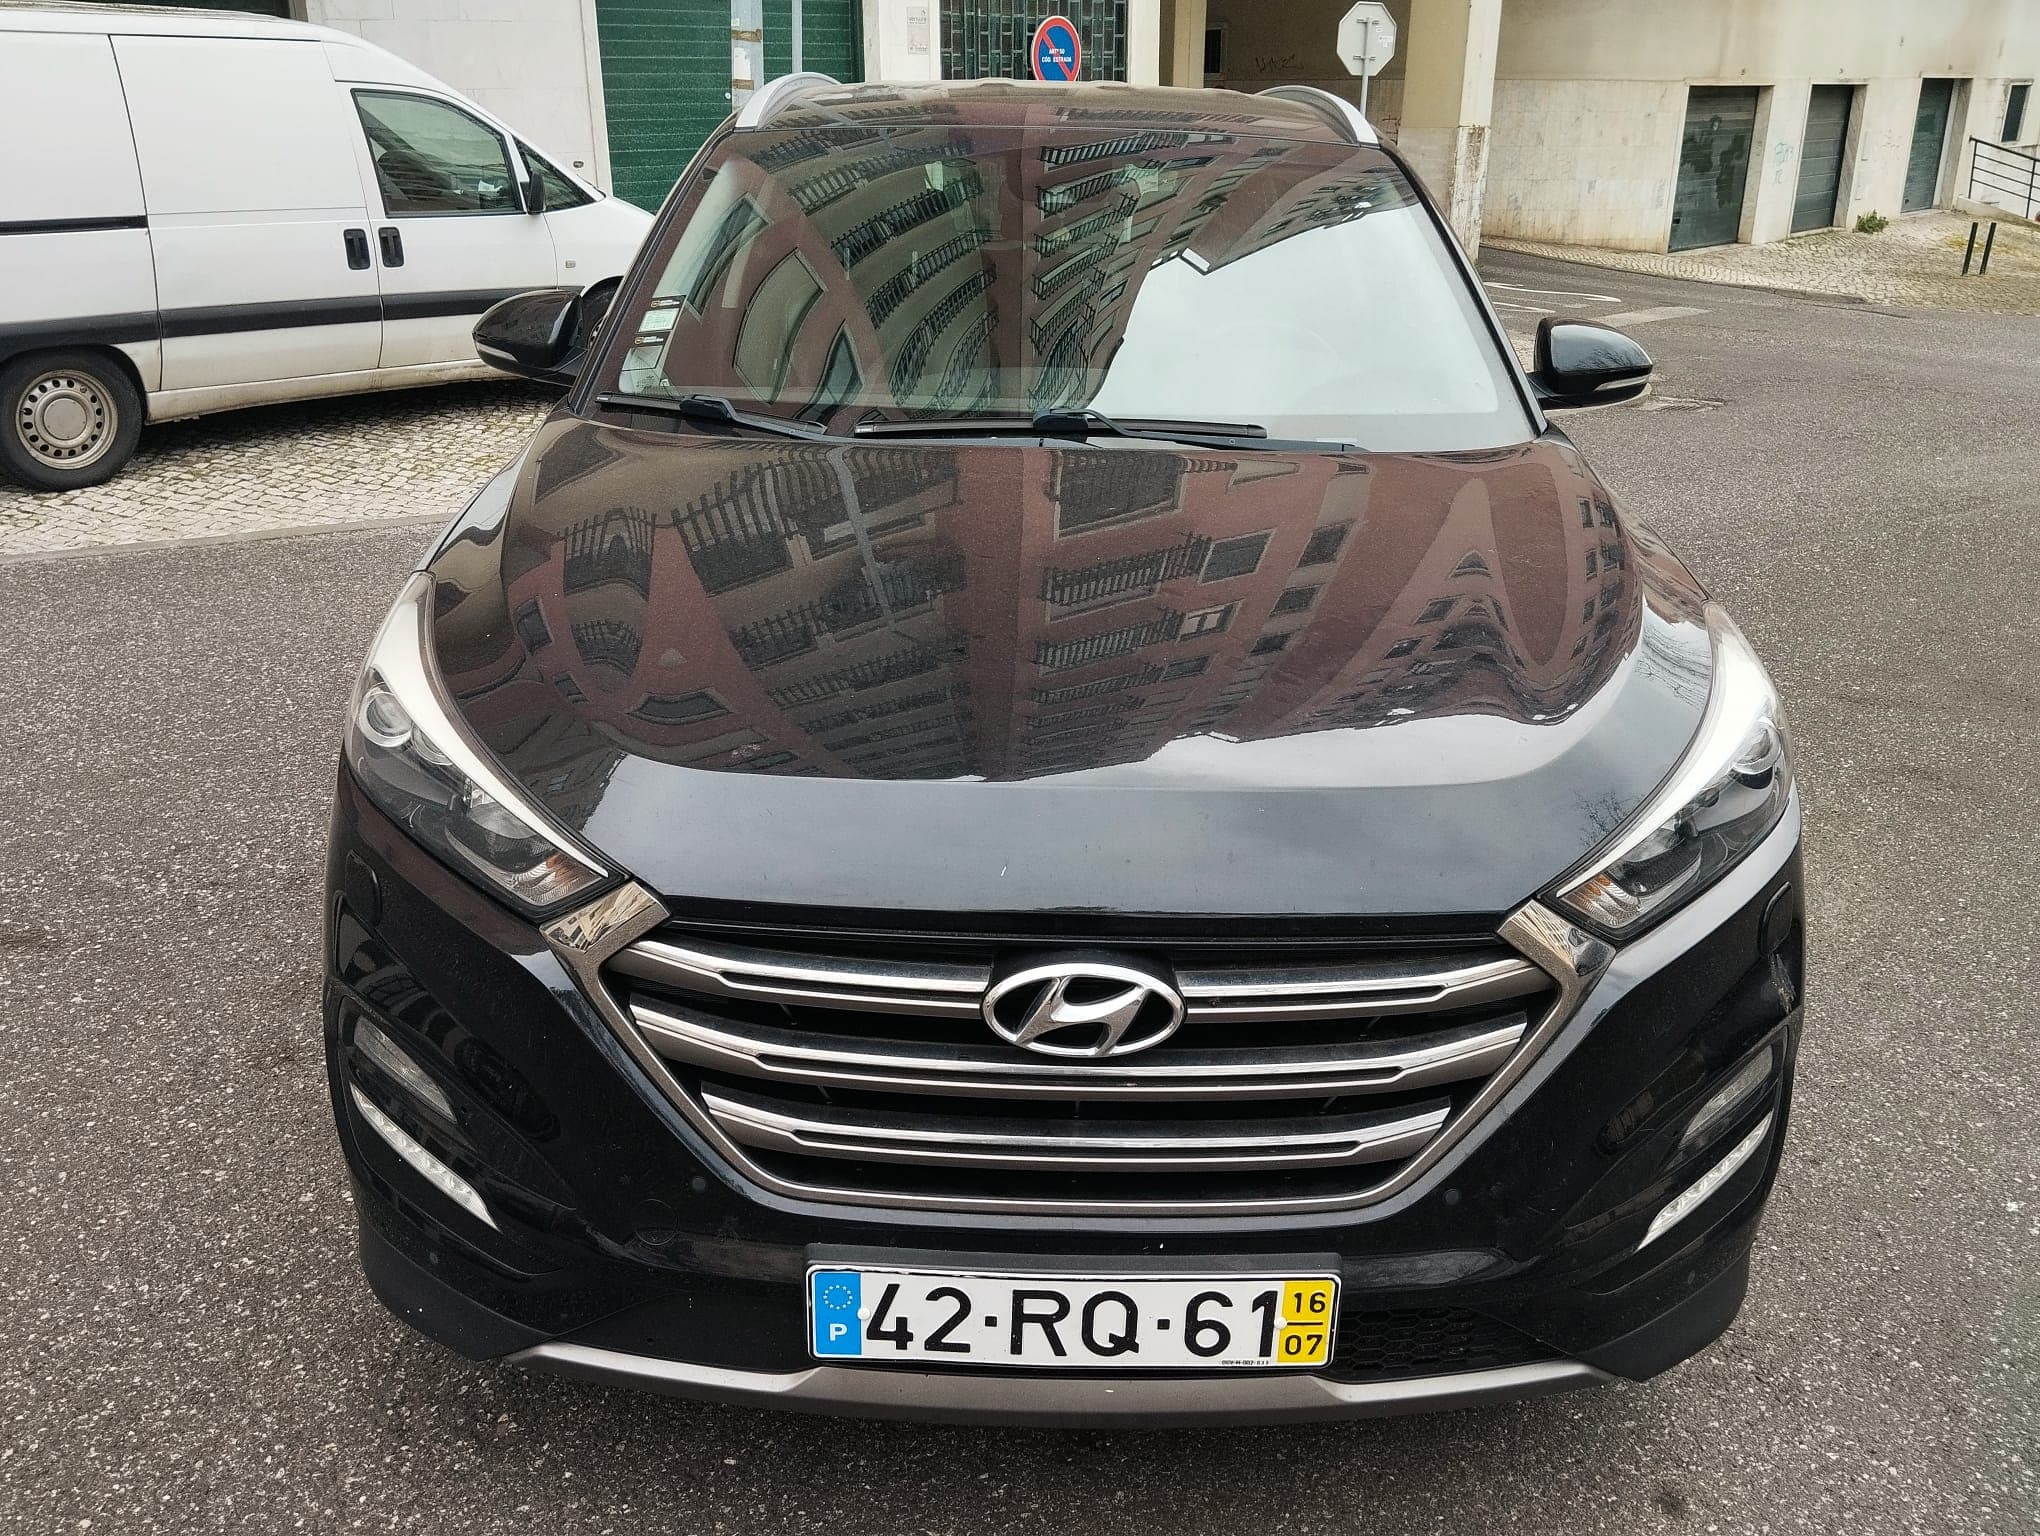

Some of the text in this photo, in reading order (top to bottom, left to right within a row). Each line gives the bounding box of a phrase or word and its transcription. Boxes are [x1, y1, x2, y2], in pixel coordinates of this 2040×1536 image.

[1292, 1290, 1326, 1314] 16
[829, 1324, 848, 1342] P
[1285, 1332, 1323, 1356] 07
